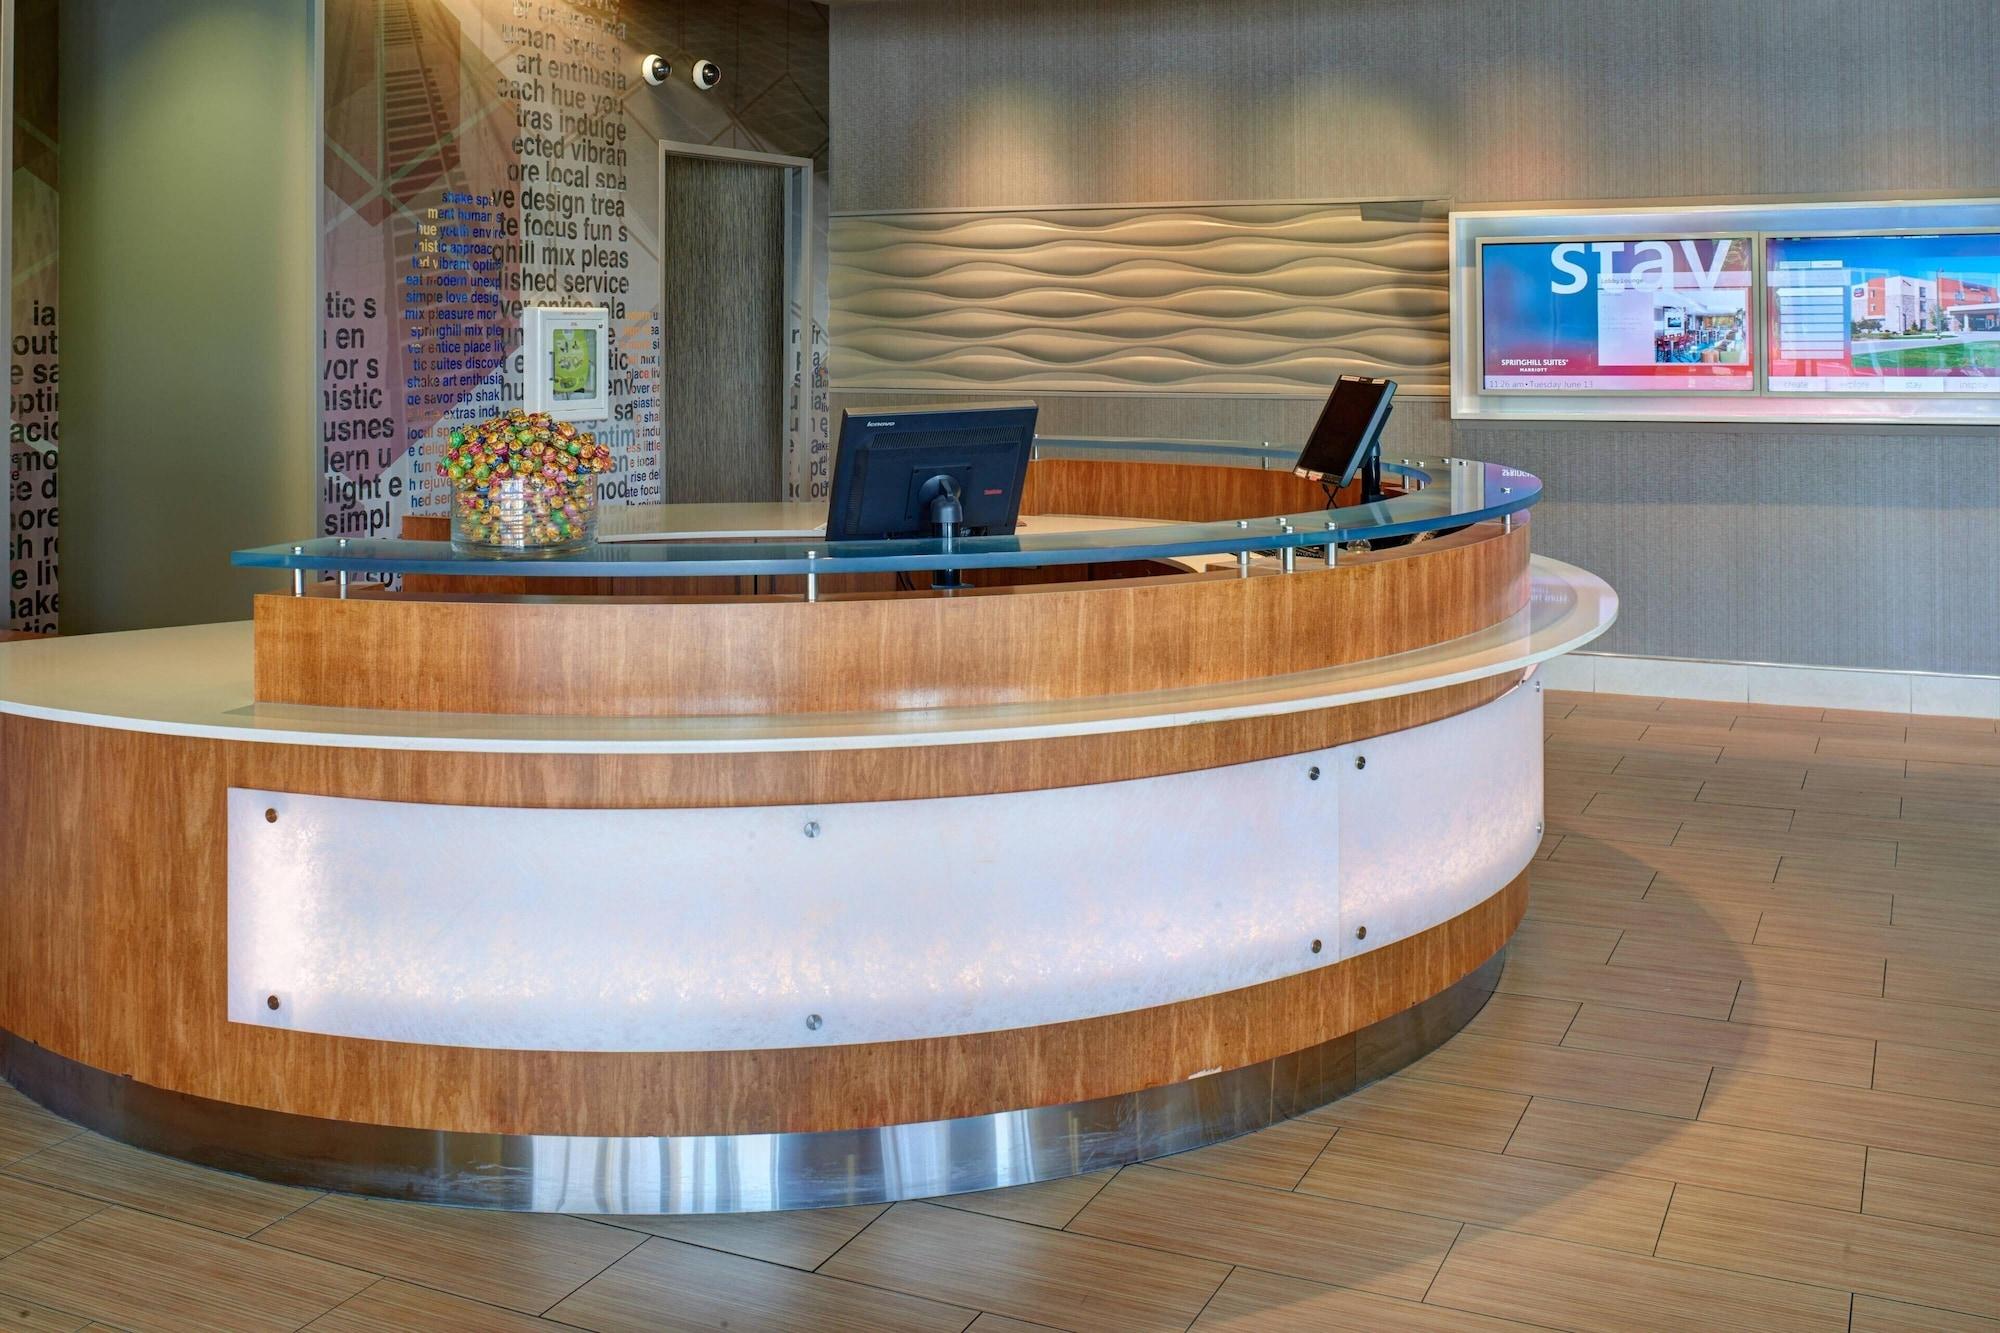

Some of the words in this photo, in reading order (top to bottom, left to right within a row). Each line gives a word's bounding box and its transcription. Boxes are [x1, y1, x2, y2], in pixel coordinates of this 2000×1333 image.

[516, 53, 542, 76] art
[548, 58, 626, 91] enthusia
[551, 81, 586, 109] hue
[559, 109, 626, 146] indulge
[511, 133, 565, 160] ected
[570, 138, 627, 167] vibran
[507, 163, 540, 183] ore
[545, 160, 589, 189] local
[521, 186, 585, 220] design
[591, 193, 625, 218] trea
[458, 209, 492, 222] human
[440, 223, 470, 240] youth
[524, 212, 578, 240] focus
[583, 216, 612, 241] fun
[432, 256, 470, 270] vibrant
[542, 242, 575, 266] mix
[581, 243, 629, 273] pleas
[563, 270, 629, 294] service
[325, 291, 356, 319] tic
[363, 297, 377, 319] s
[406, 290, 443, 306] simple
[445, 289, 468, 304] love
[471, 291, 499, 307] desig
[33, 300, 56, 326] ia
[405, 306, 425, 320] mix
[428, 306, 474, 323] pleasure
[410, 323, 462, 340] springhill
[464, 324, 484, 337] mix
[12, 330, 58, 356] out
[428, 340, 461, 353] entice
[463, 341, 491, 356] place
[366, 358, 379, 379] s
[430, 357, 463, 371] suites
[407, 374, 440, 389] shake
[442, 374, 458, 387] art
[1529, 380, 1562, 390] Tuesday
[424, 391, 455, 405] savor
[457, 389, 473, 405] sip
[443, 406, 476, 420] extras
[323, 417, 395, 443] usnes
[407, 426, 433, 440] local
[378, 447, 391, 468] u
[413, 460, 432, 474] fun
[630, 470, 647, 482] rise
[324, 473, 382, 512] light
[388, 476, 403, 498] e
[640, 484, 661, 496] focu
[411, 494, 432, 508] hed
[324, 501, 390, 537] simpl
